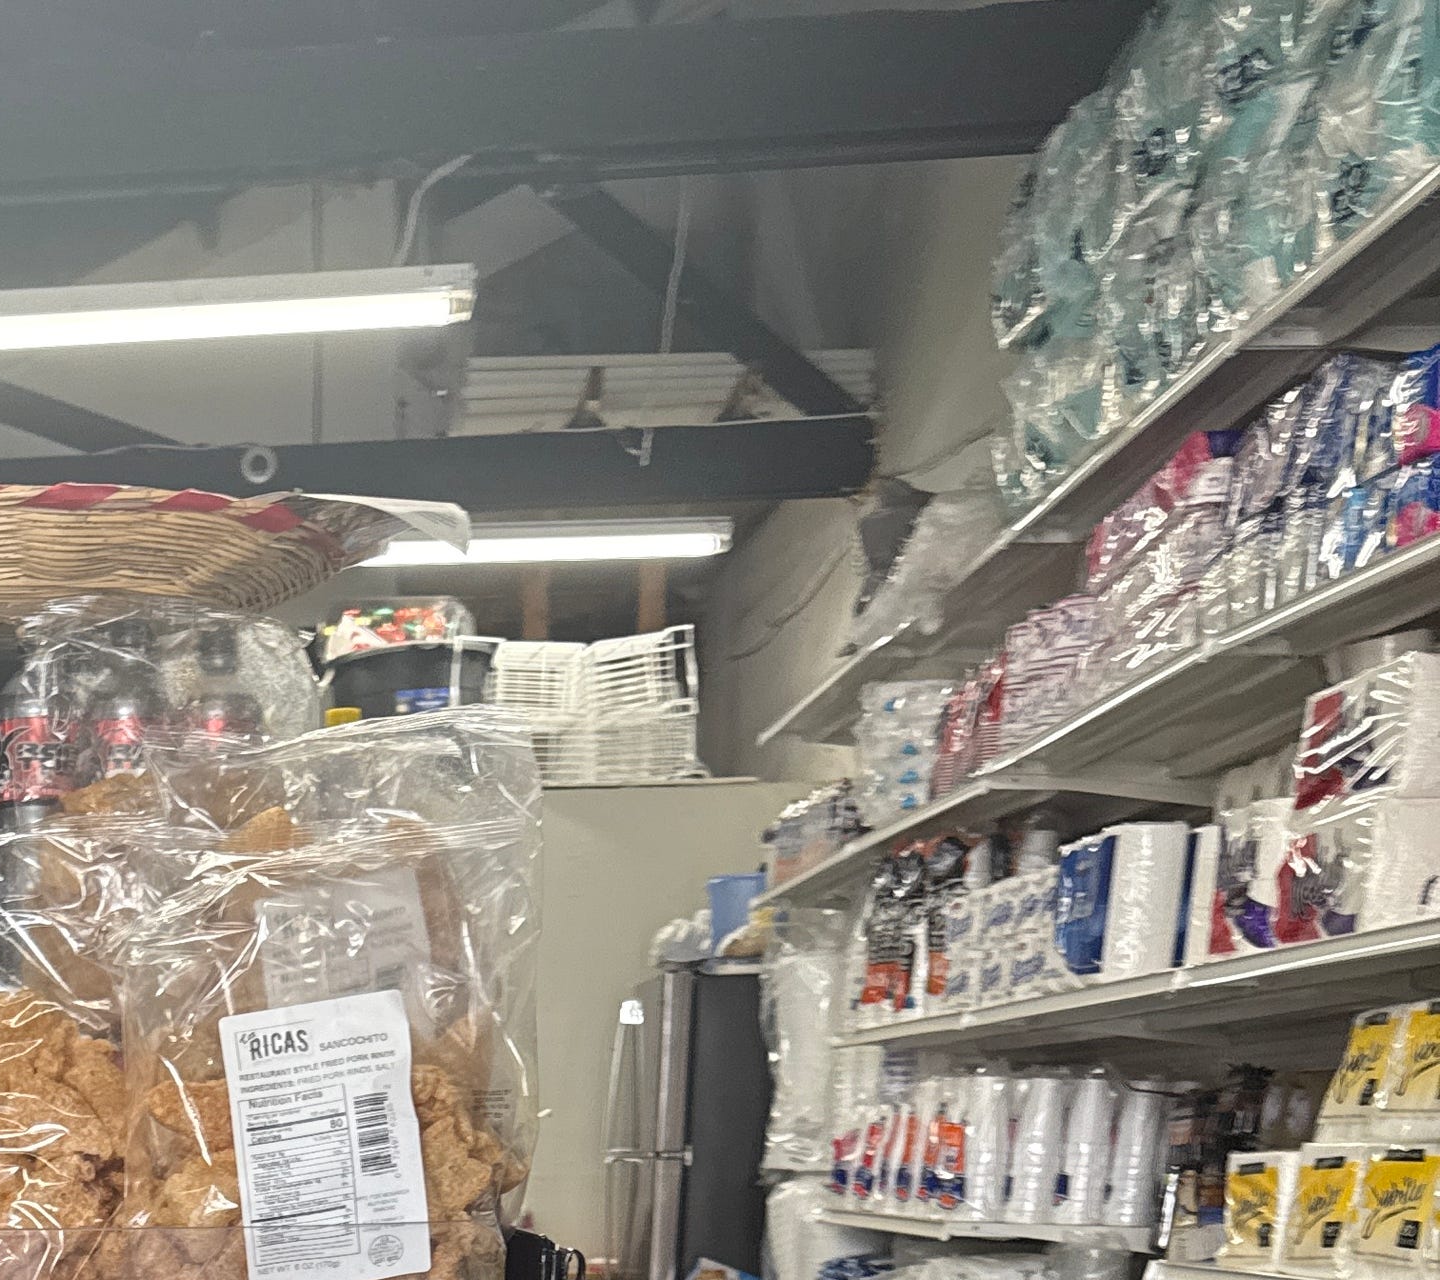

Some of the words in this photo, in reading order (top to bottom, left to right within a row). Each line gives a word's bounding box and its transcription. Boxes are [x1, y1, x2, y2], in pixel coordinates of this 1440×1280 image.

[250, 1030, 310, 1061] RICAS
[319, 1033, 389, 1051] SANCOCHITO
[239, 1068, 292, 1081] RESTAURANT
[293, 1063, 319, 1074] STYLE
[321, 1059, 345, 1069] FRIED
[346, 1054, 369, 1064] PORK
[323, 1071, 345, 1080] PORK
[248, 1095, 292, 1109] Nutrition
[294, 1091, 323, 1102] Facts
